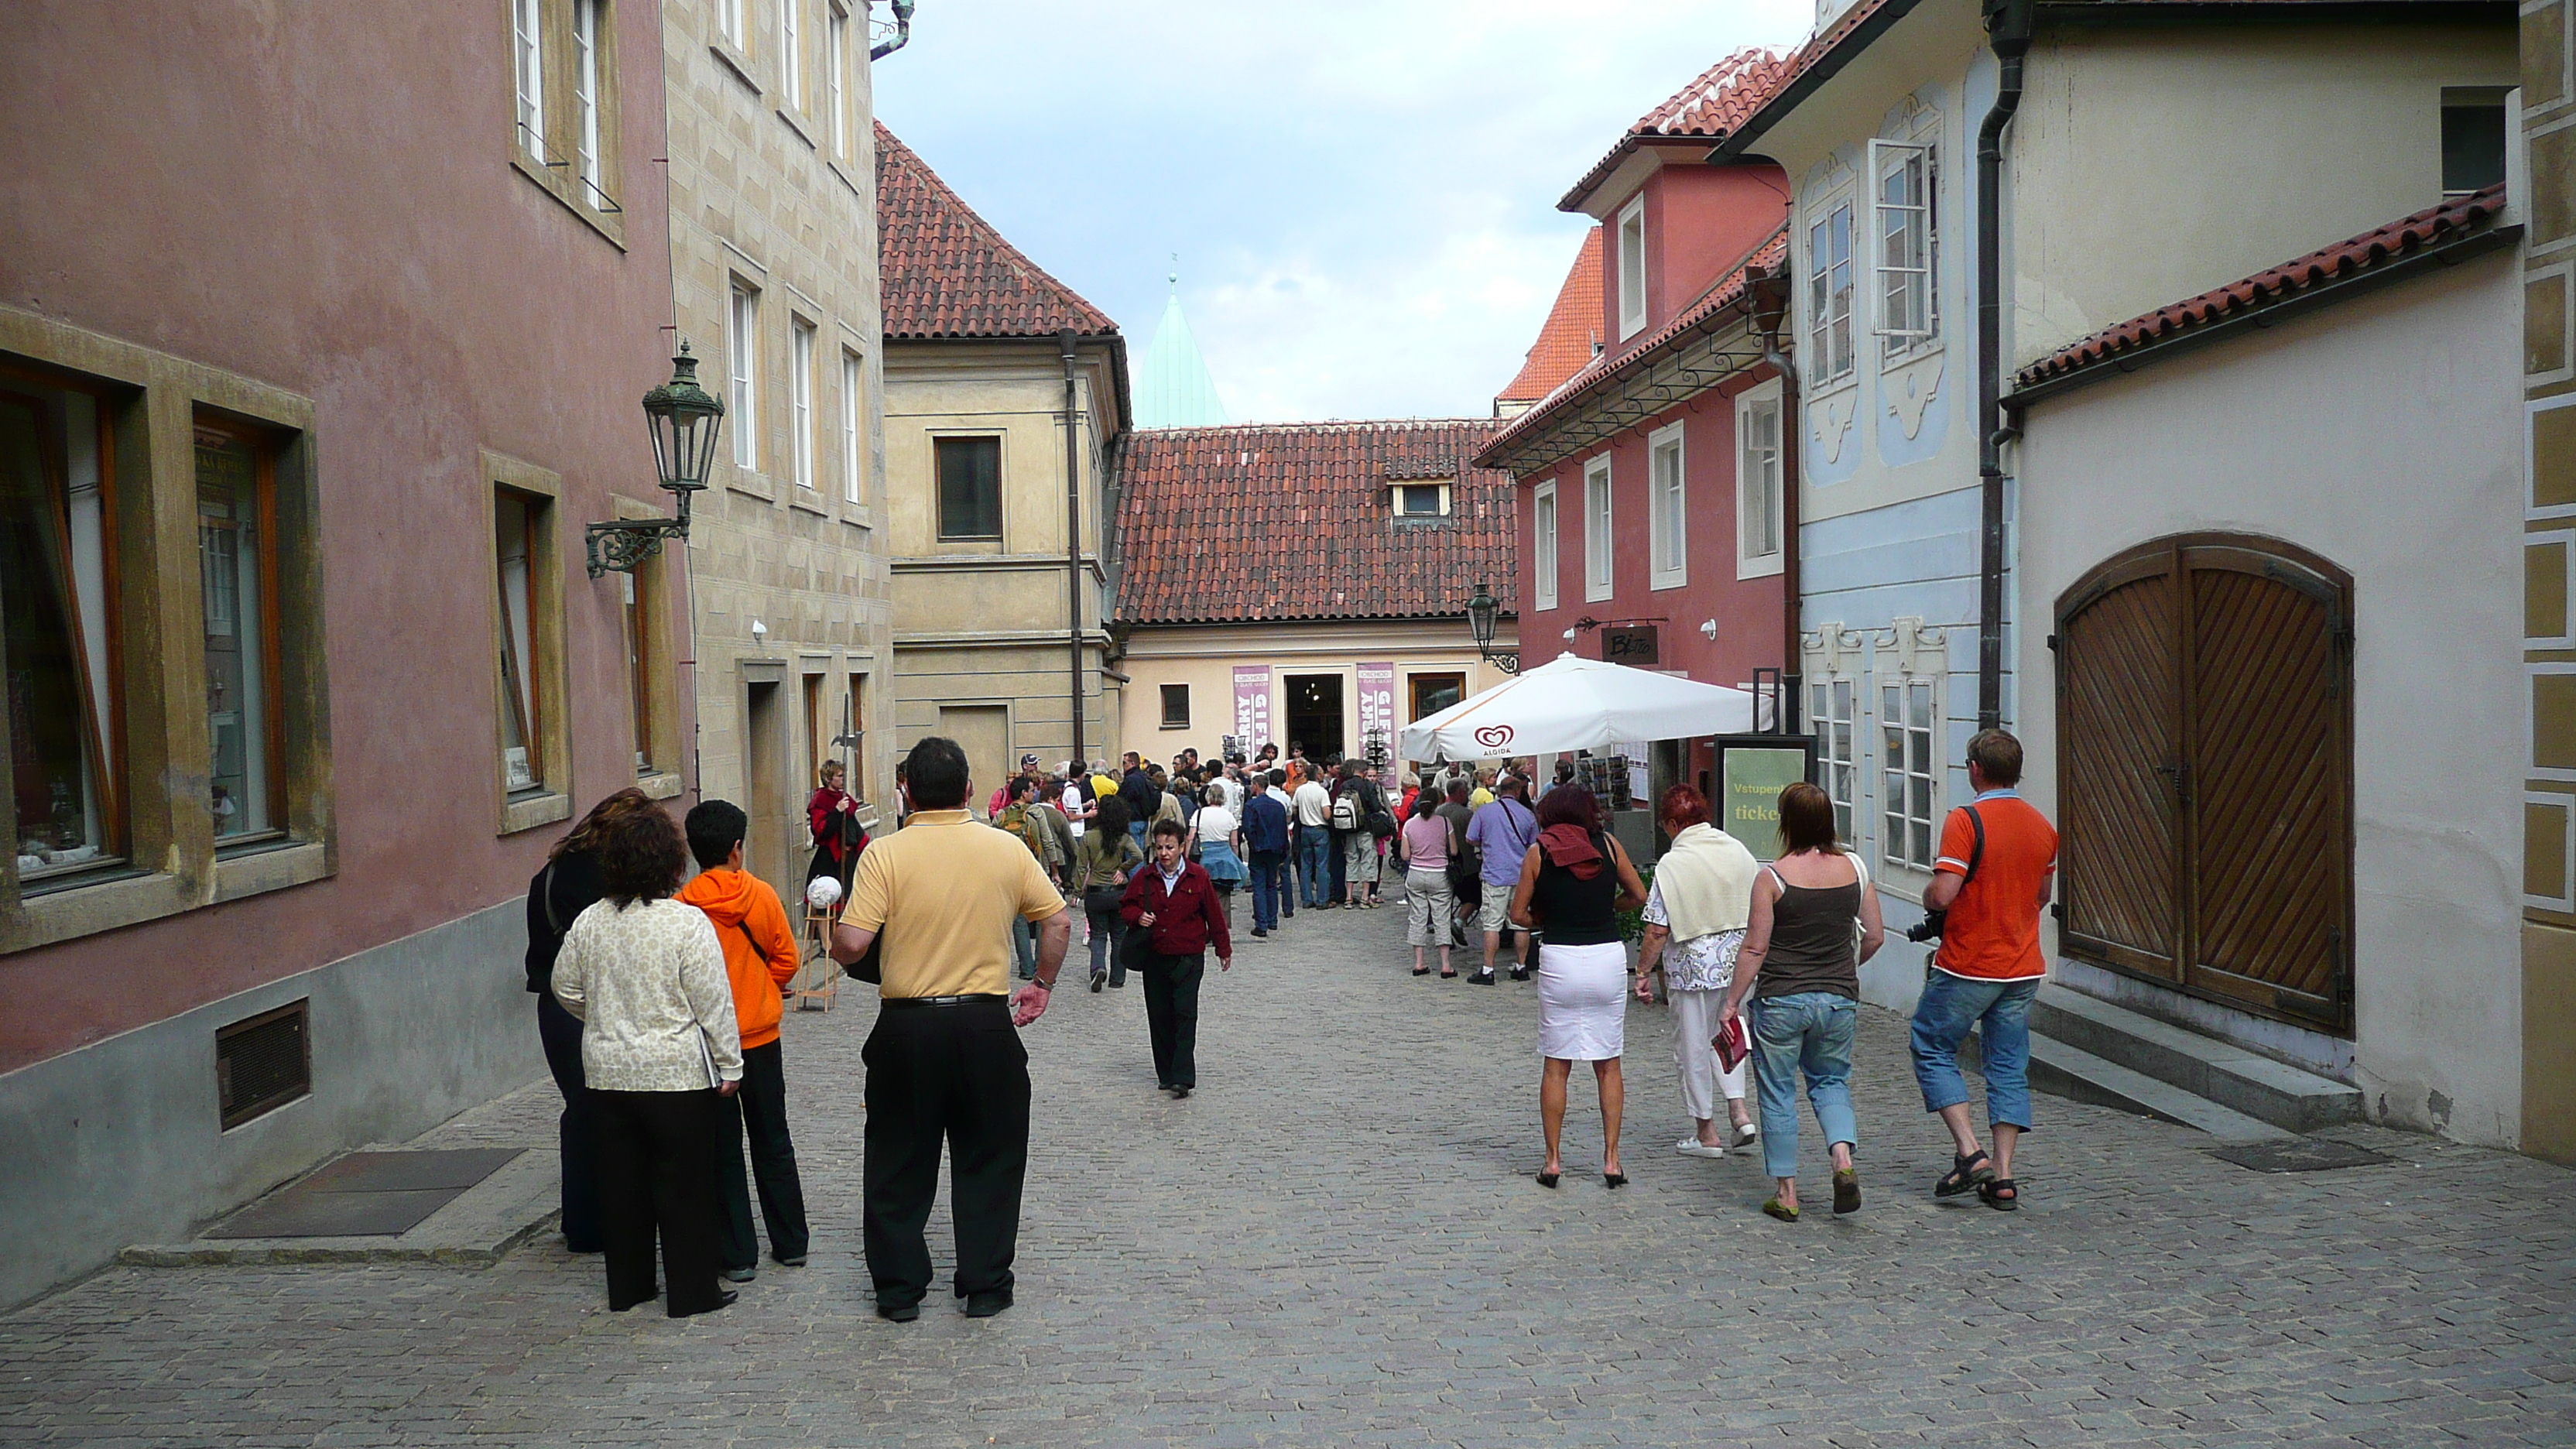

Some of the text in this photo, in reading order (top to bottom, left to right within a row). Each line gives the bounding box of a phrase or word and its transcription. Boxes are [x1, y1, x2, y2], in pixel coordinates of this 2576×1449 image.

[1255, 694, 1267, 756] GIFT
[1483, 748, 1511, 756] ALGIDA
[1735, 804, 1780, 821] ticke
